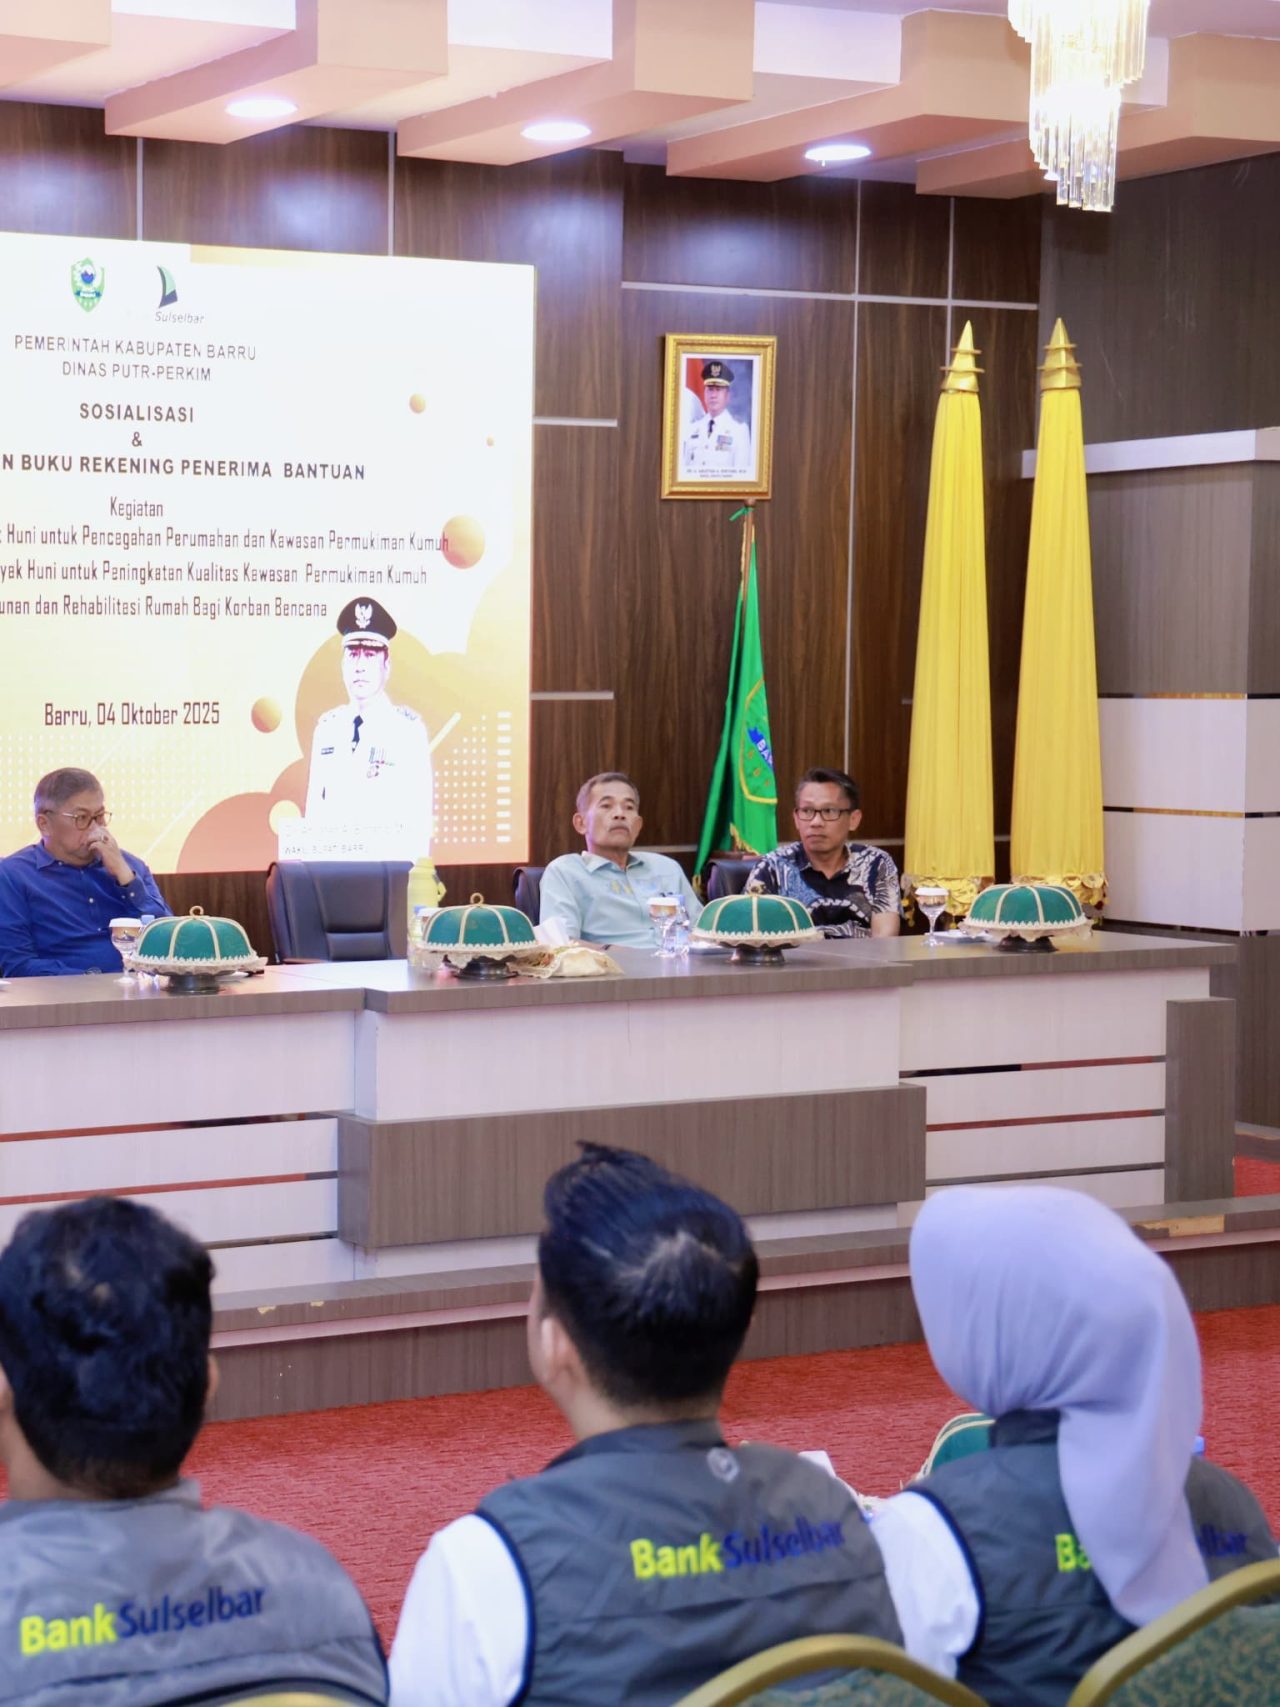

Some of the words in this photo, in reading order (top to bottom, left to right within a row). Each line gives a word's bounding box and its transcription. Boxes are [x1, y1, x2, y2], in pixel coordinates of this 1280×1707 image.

[154, 310, 206, 326] Sulselbar
[14, 334, 110, 353] PEMERINTAH
[115, 339, 202, 358] KABUPATEN
[206, 343, 256, 361] BARRU
[62, 360, 107, 378] DINAS
[112, 363, 211, 382] PUTR-PERKIM
[79, 402, 194, 424] SOSIALISASI
[131, 431, 143, 448] &
[21, 453, 73, 472] BUKU
[79, 455, 174, 475] REKENING
[181, 459, 272, 478] PENERIMA
[283, 462, 365, 481] BANTUAN
[109, 495, 164, 521] Kegiatan
[6, 522, 36, 545] Huni
[40, 524, 78, 545] untuk
[82, 524, 162, 551] Pencegahan
[166, 526, 239, 548] Perumahan
[243, 528, 266, 549] dan
[269, 528, 325, 550] Kawasan
[409, 532, 451, 552] Kumuh
[27, 558, 57, 580] Huni
[61, 559, 98, 581] untuk
[102, 559, 183, 586] Peningkatan
[187, 561, 239, 583] Kualitas
[243, 562, 298, 583] Kawasan
[387, 564, 427, 585] Kumuh
[35, 593, 59, 616] dan
[63, 594, 141, 616] Rehabilitasi
[145, 595, 189, 616] Rumah
[193, 595, 221, 621] Bagi
[224, 595, 270, 617] Korban
[274, 596, 327, 617] Bencana
[44, 702, 92, 728] Barru,
[96, 702, 116, 726] 04
[121, 701, 179, 726] Oktober
[183, 701, 220, 725] 2025
